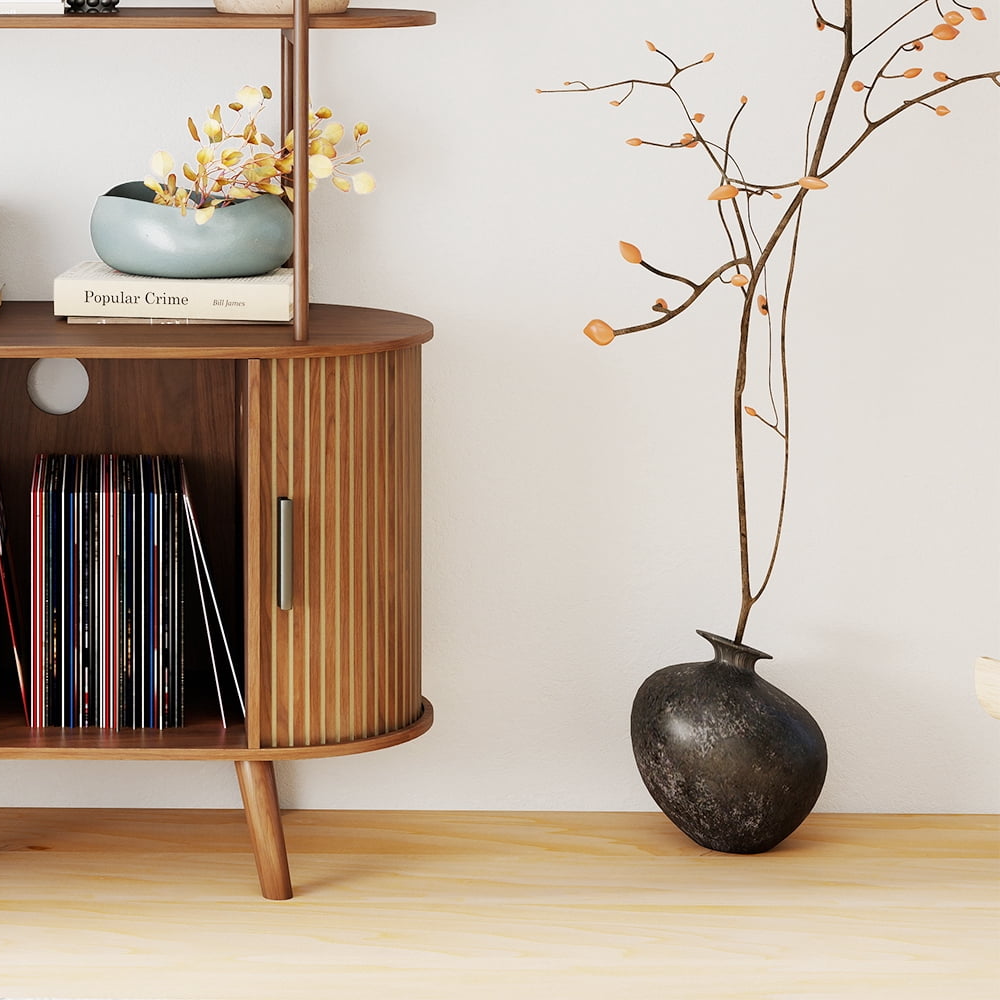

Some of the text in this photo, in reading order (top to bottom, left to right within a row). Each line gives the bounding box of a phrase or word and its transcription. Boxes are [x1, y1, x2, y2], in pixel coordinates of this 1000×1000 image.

[84, 290, 189, 306] Popular Crime
[212, 299, 246, 308] Bill James
